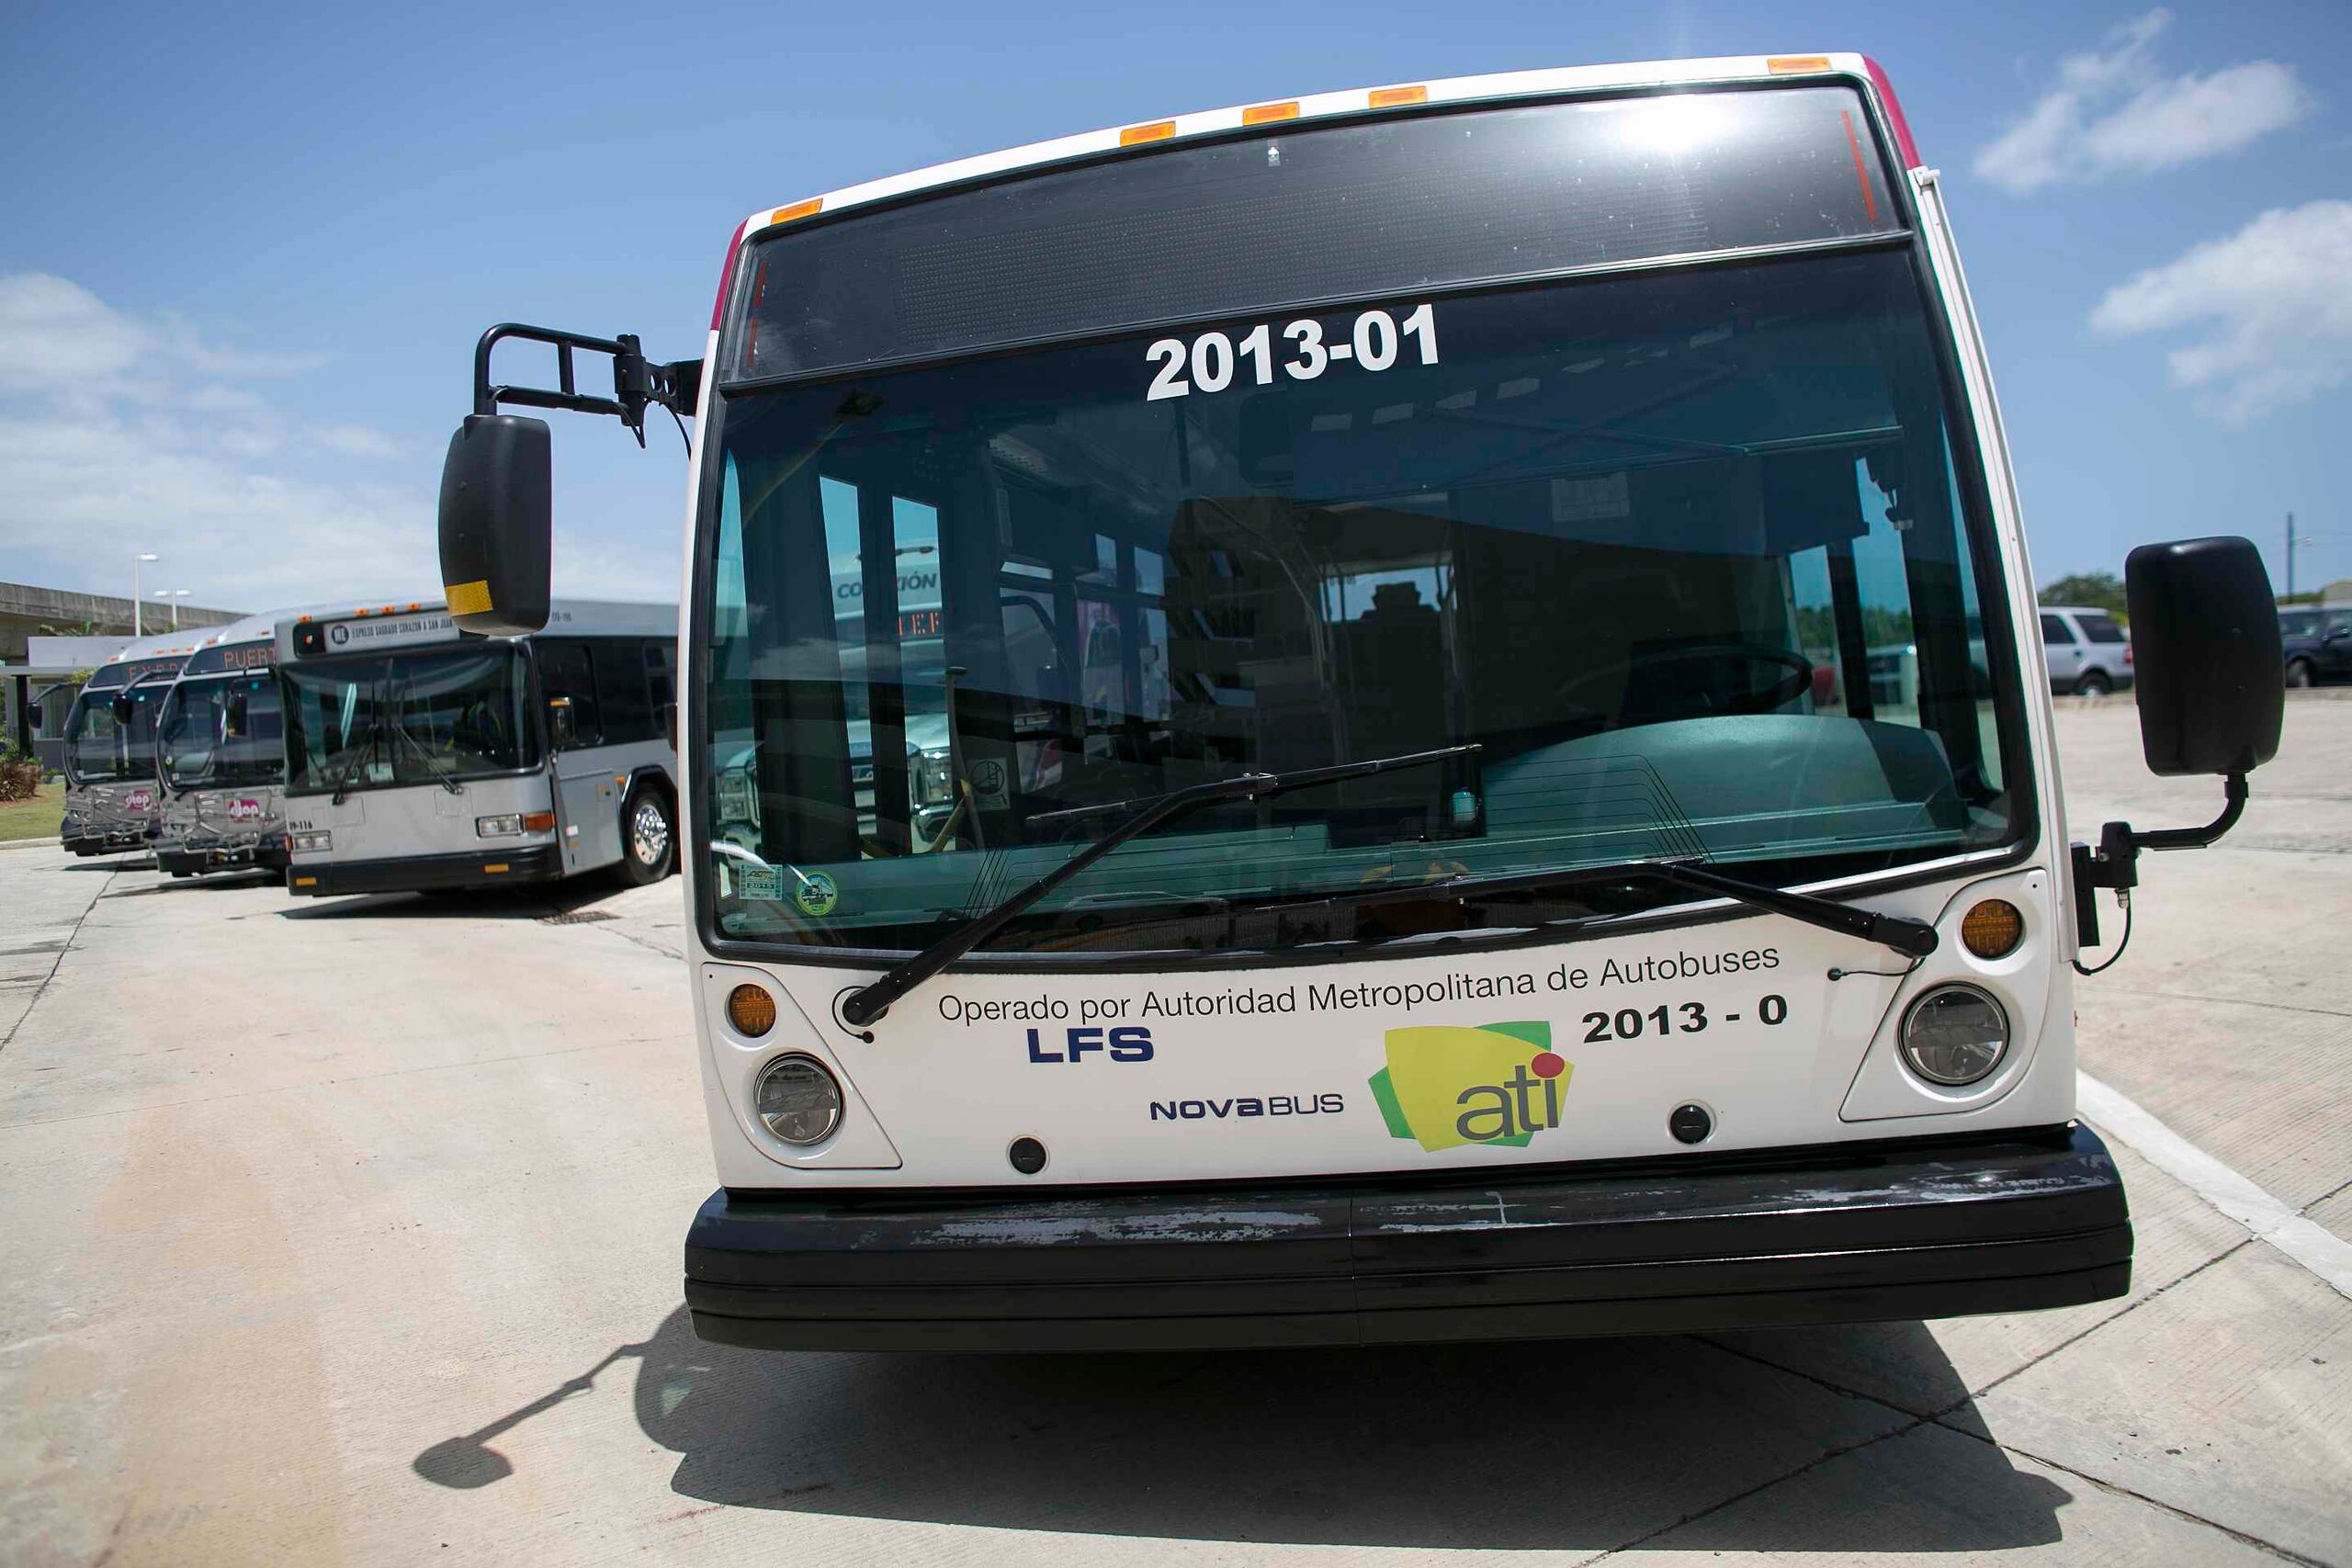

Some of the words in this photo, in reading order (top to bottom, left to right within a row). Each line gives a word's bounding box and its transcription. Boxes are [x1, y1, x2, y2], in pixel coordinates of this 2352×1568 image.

[1146, 303, 1439, 401] 2013-01
[428, 619, 439, 631] SAN
[938, 994, 1070, 1027] Operado
[1080, 998, 1131, 1026] por
[1141, 986, 1296, 1018] Autoridad
[1308, 974, 1536, 1014] Metropolitana
[1546, 963, 1589, 991] de
[1600, 948, 1780, 987] Autobuses
[1582, 1000, 1708, 1043] 2013
[1758, 994, 1788, 1026] 0
[1026, 1026, 1154, 1064] LFS
[1456, 1052, 1566, 1142] ati
